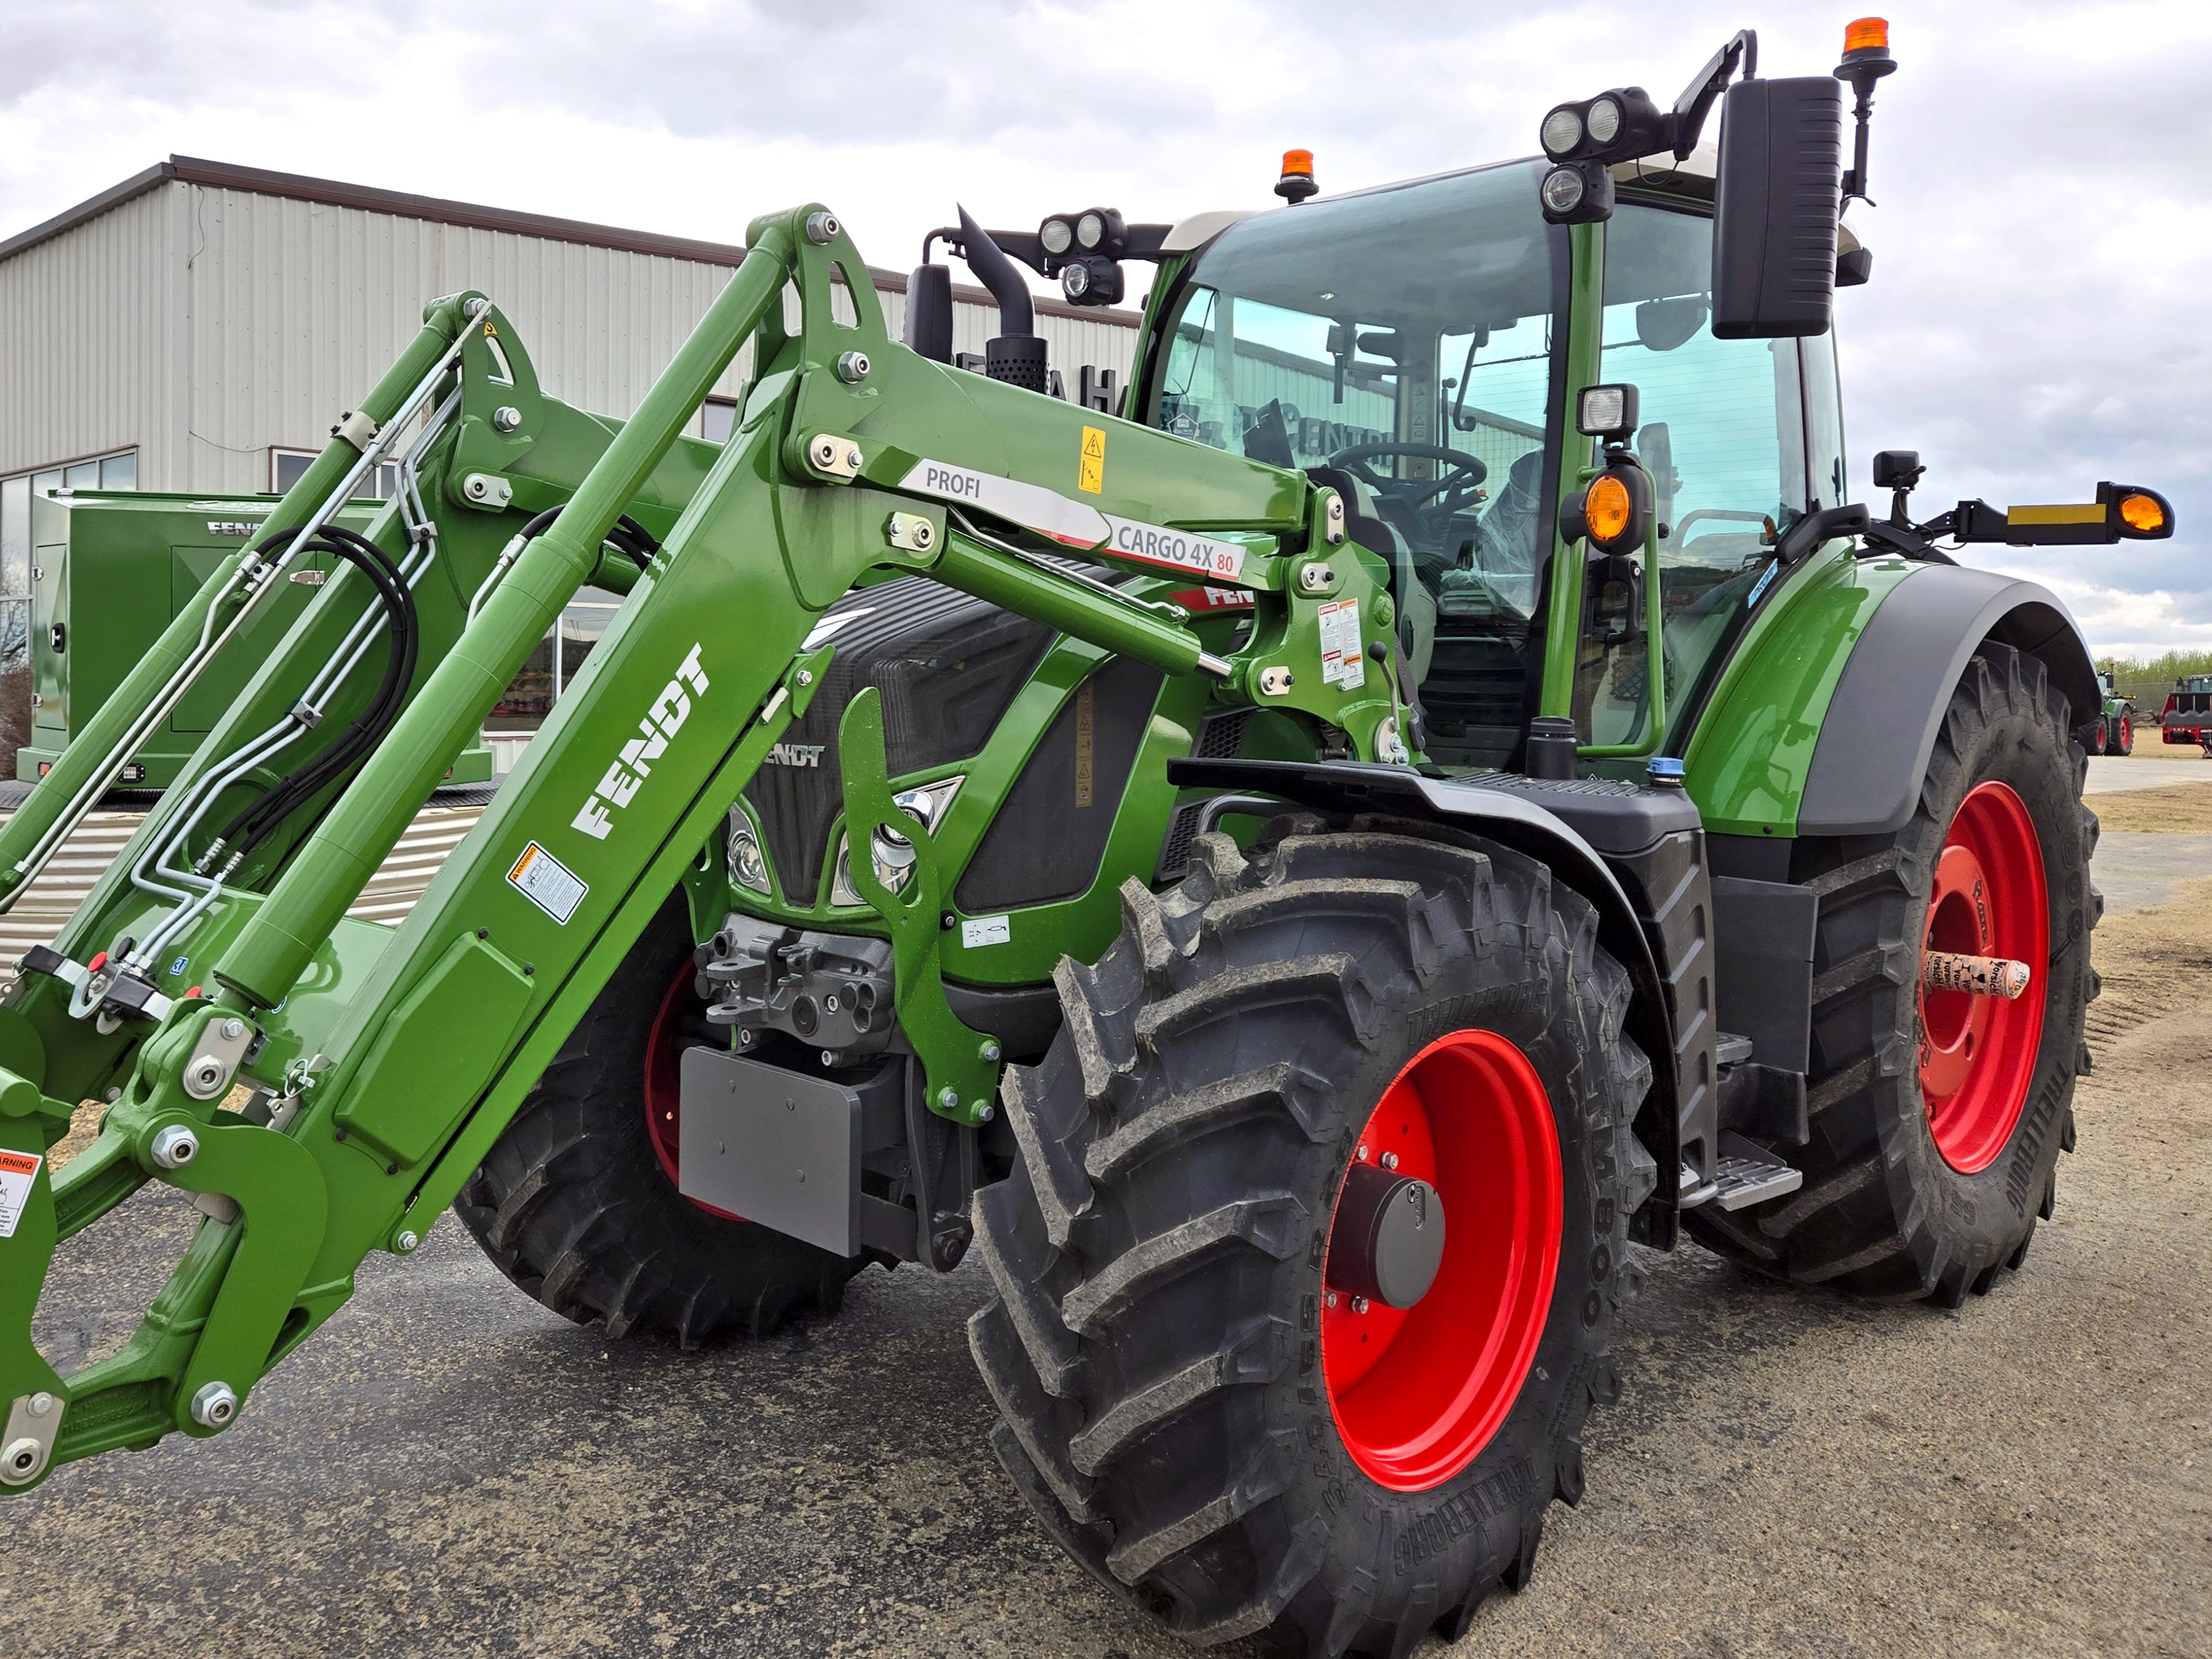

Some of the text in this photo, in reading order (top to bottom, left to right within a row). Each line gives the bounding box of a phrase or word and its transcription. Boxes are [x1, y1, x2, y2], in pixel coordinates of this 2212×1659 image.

[927, 467, 980, 498] PROFI
[206, 521, 261, 536] FEN
[1118, 526, 1234, 572] CARGO 4X 80
[1203, 586, 1255, 606] FEN
[570, 641, 710, 840] FENDT
[516, 846, 537, 874] WARNING
[1406, 977, 1549, 1046] TRELLEBORG
[2006, 1061, 2071, 1221] TRELLEBORG
[1394, 1457, 1537, 1577] TRELLEBORG
